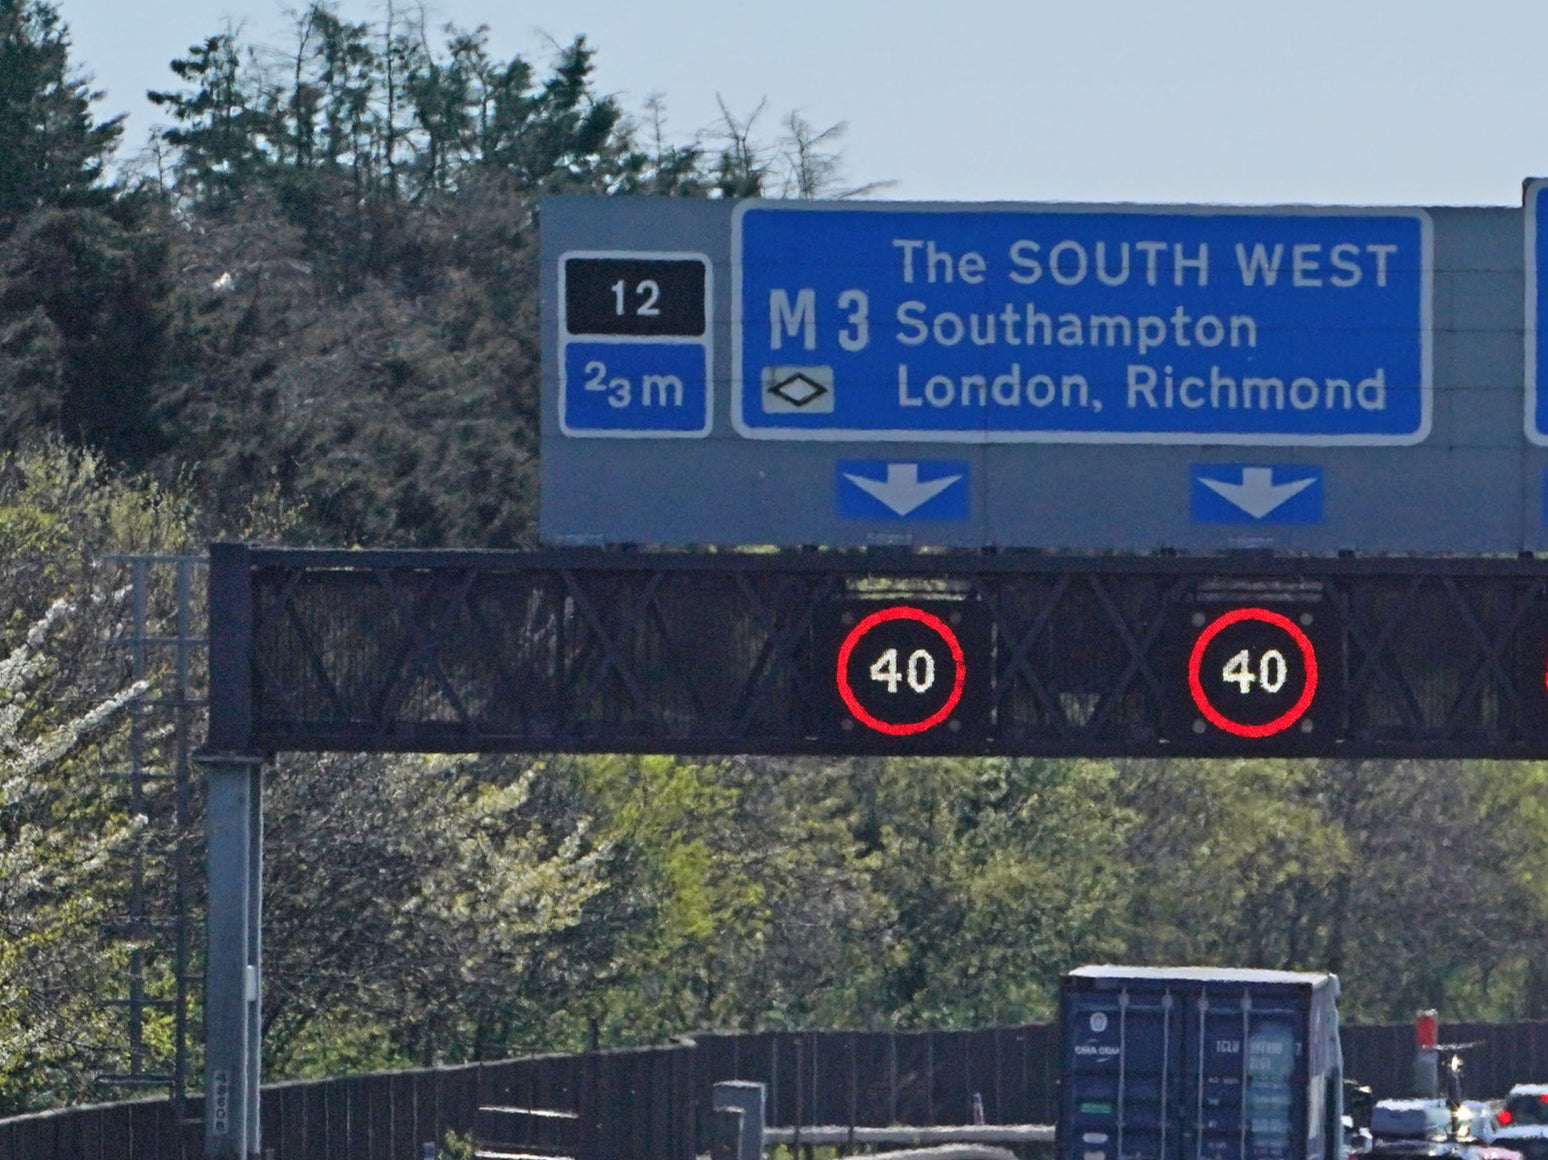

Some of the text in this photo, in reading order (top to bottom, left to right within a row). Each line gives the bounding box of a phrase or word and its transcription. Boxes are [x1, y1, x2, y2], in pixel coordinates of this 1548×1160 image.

[893, 239, 1398, 287] The SOUTH WEST
[611, 280, 660, 317] 12
[896, 300, 1257, 354] Southampton
[899, 363, 1386, 413] London, Richmond
[870, 649, 935, 693] 40
[1223, 649, 1287, 694] 40
